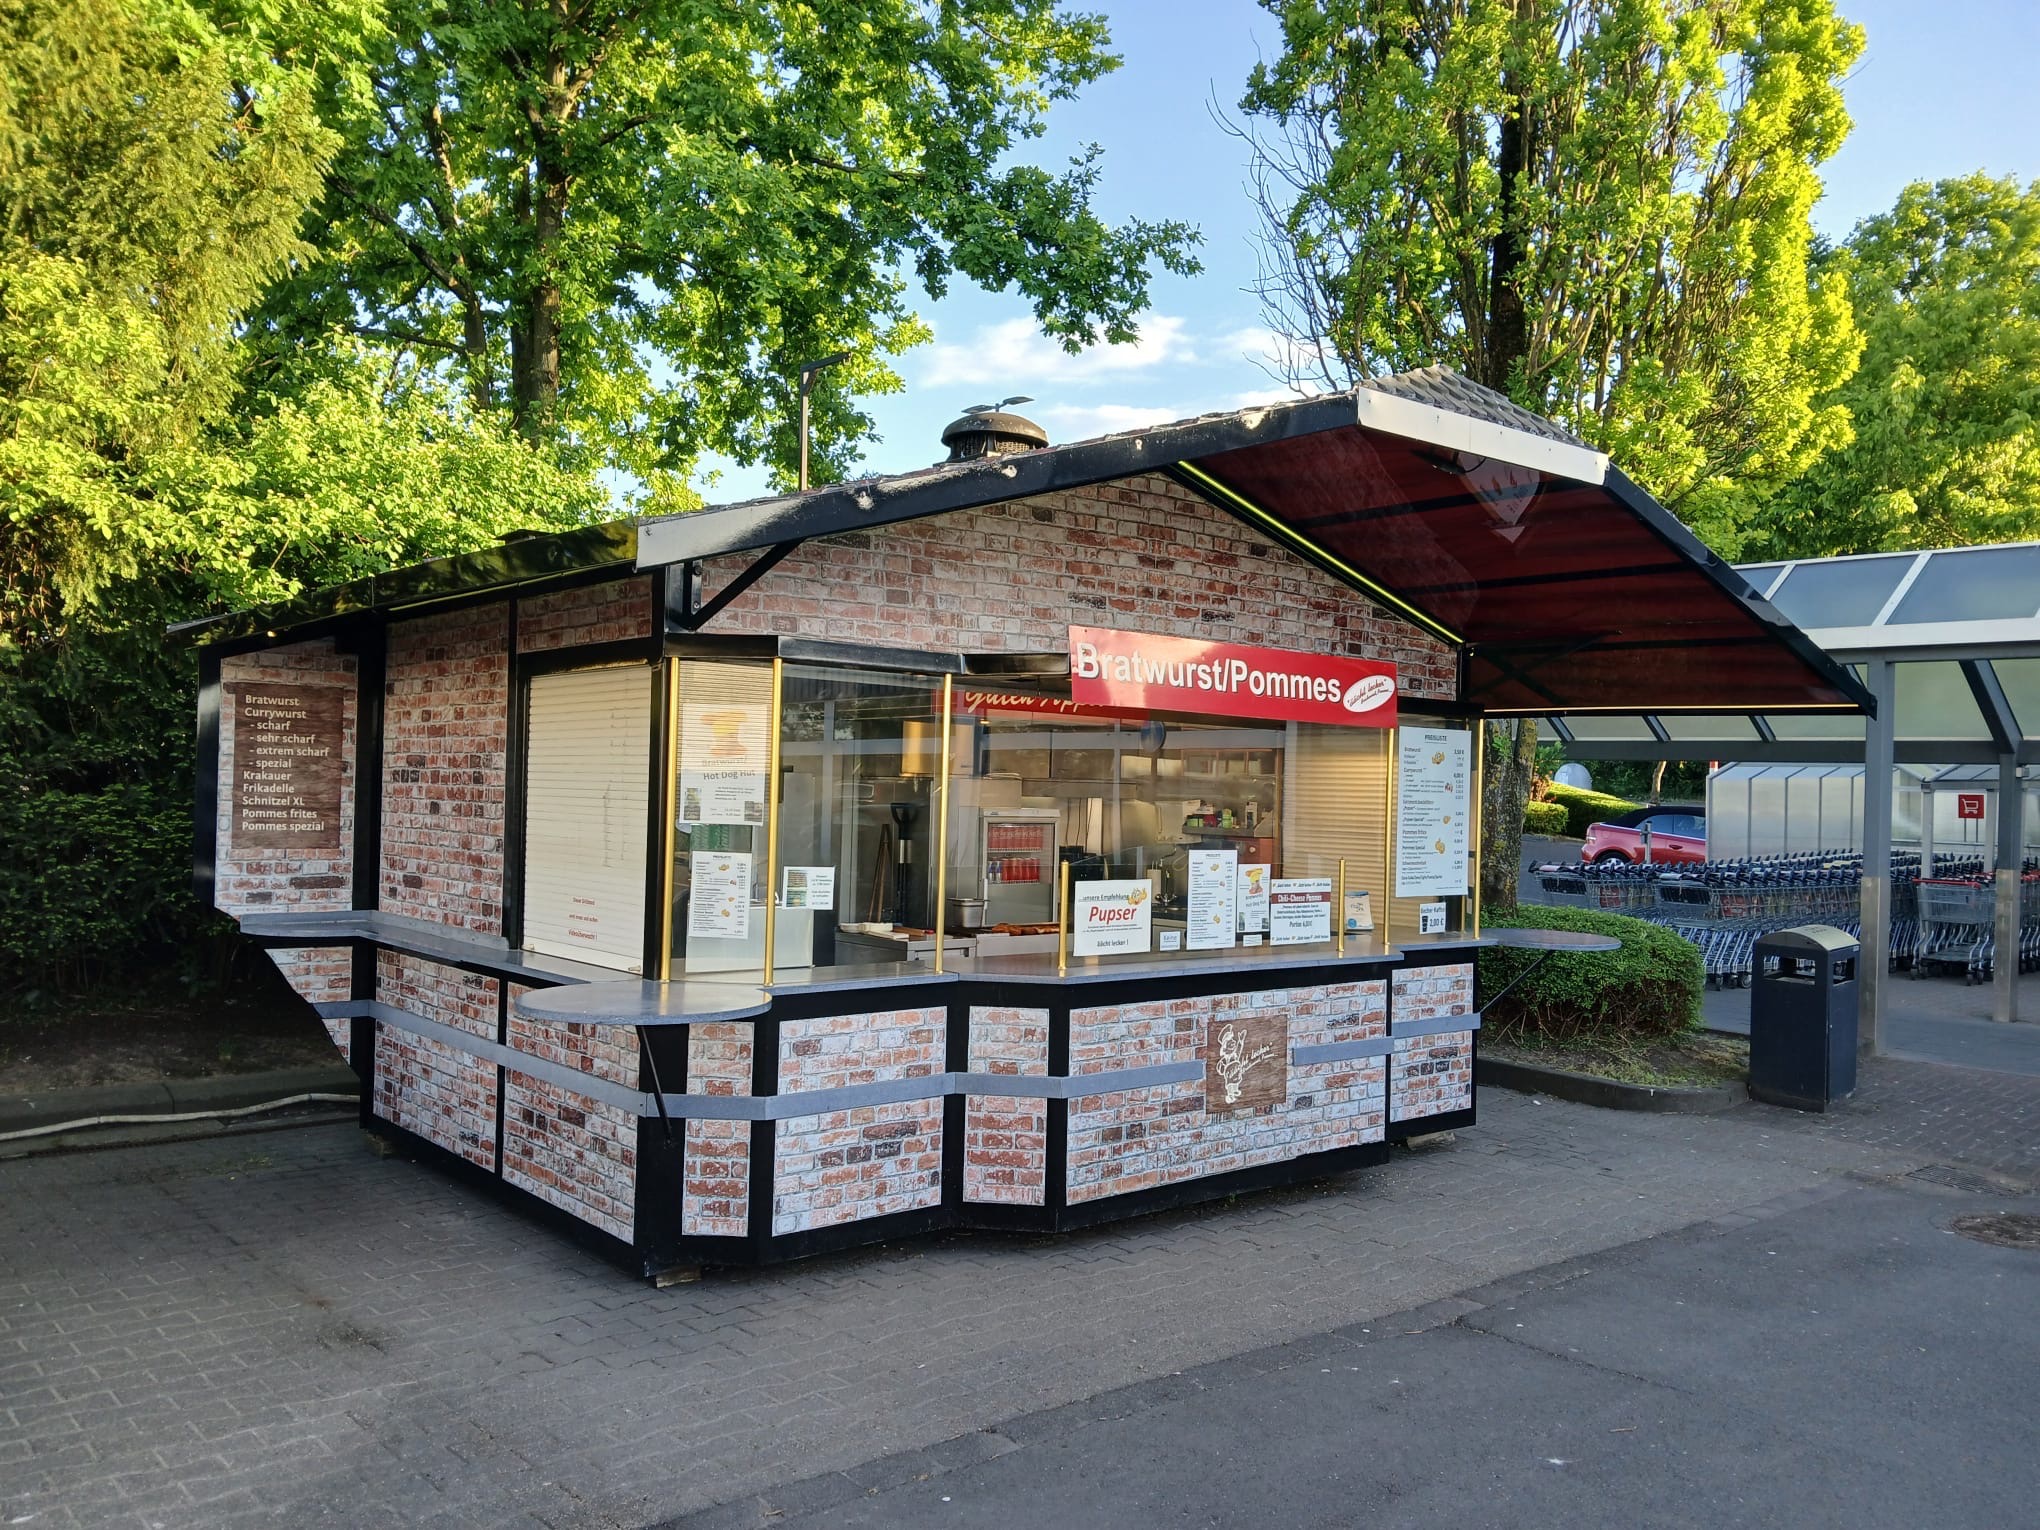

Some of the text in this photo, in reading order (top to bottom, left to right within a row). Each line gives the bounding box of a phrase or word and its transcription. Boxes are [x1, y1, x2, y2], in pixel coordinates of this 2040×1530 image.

[1077, 642, 1342, 703] Bratwurst/Pommes
[245, 694, 300, 706] Bratwurst
[244, 707, 307, 720] Currywurst
[256, 720, 291, 731] scharf
[256, 733, 280, 743] sehr
[282, 734, 315, 745] scharf
[256, 747, 294, 756] extrem
[296, 746, 330, 757] scharf
[255, 759, 292, 769] spezial
[243, 770, 292, 781] Krakauer
[703, 772, 719, 780] Hot
[721, 771, 738, 780] Dog
[243, 783, 295, 793] Frikadelle
[242, 796, 305, 806] Schnitzel XL
[242, 808, 317, 819] Pommes frites
[241, 821, 325, 832] Pommes spezial
[1089, 906, 1137, 925] Pupser
